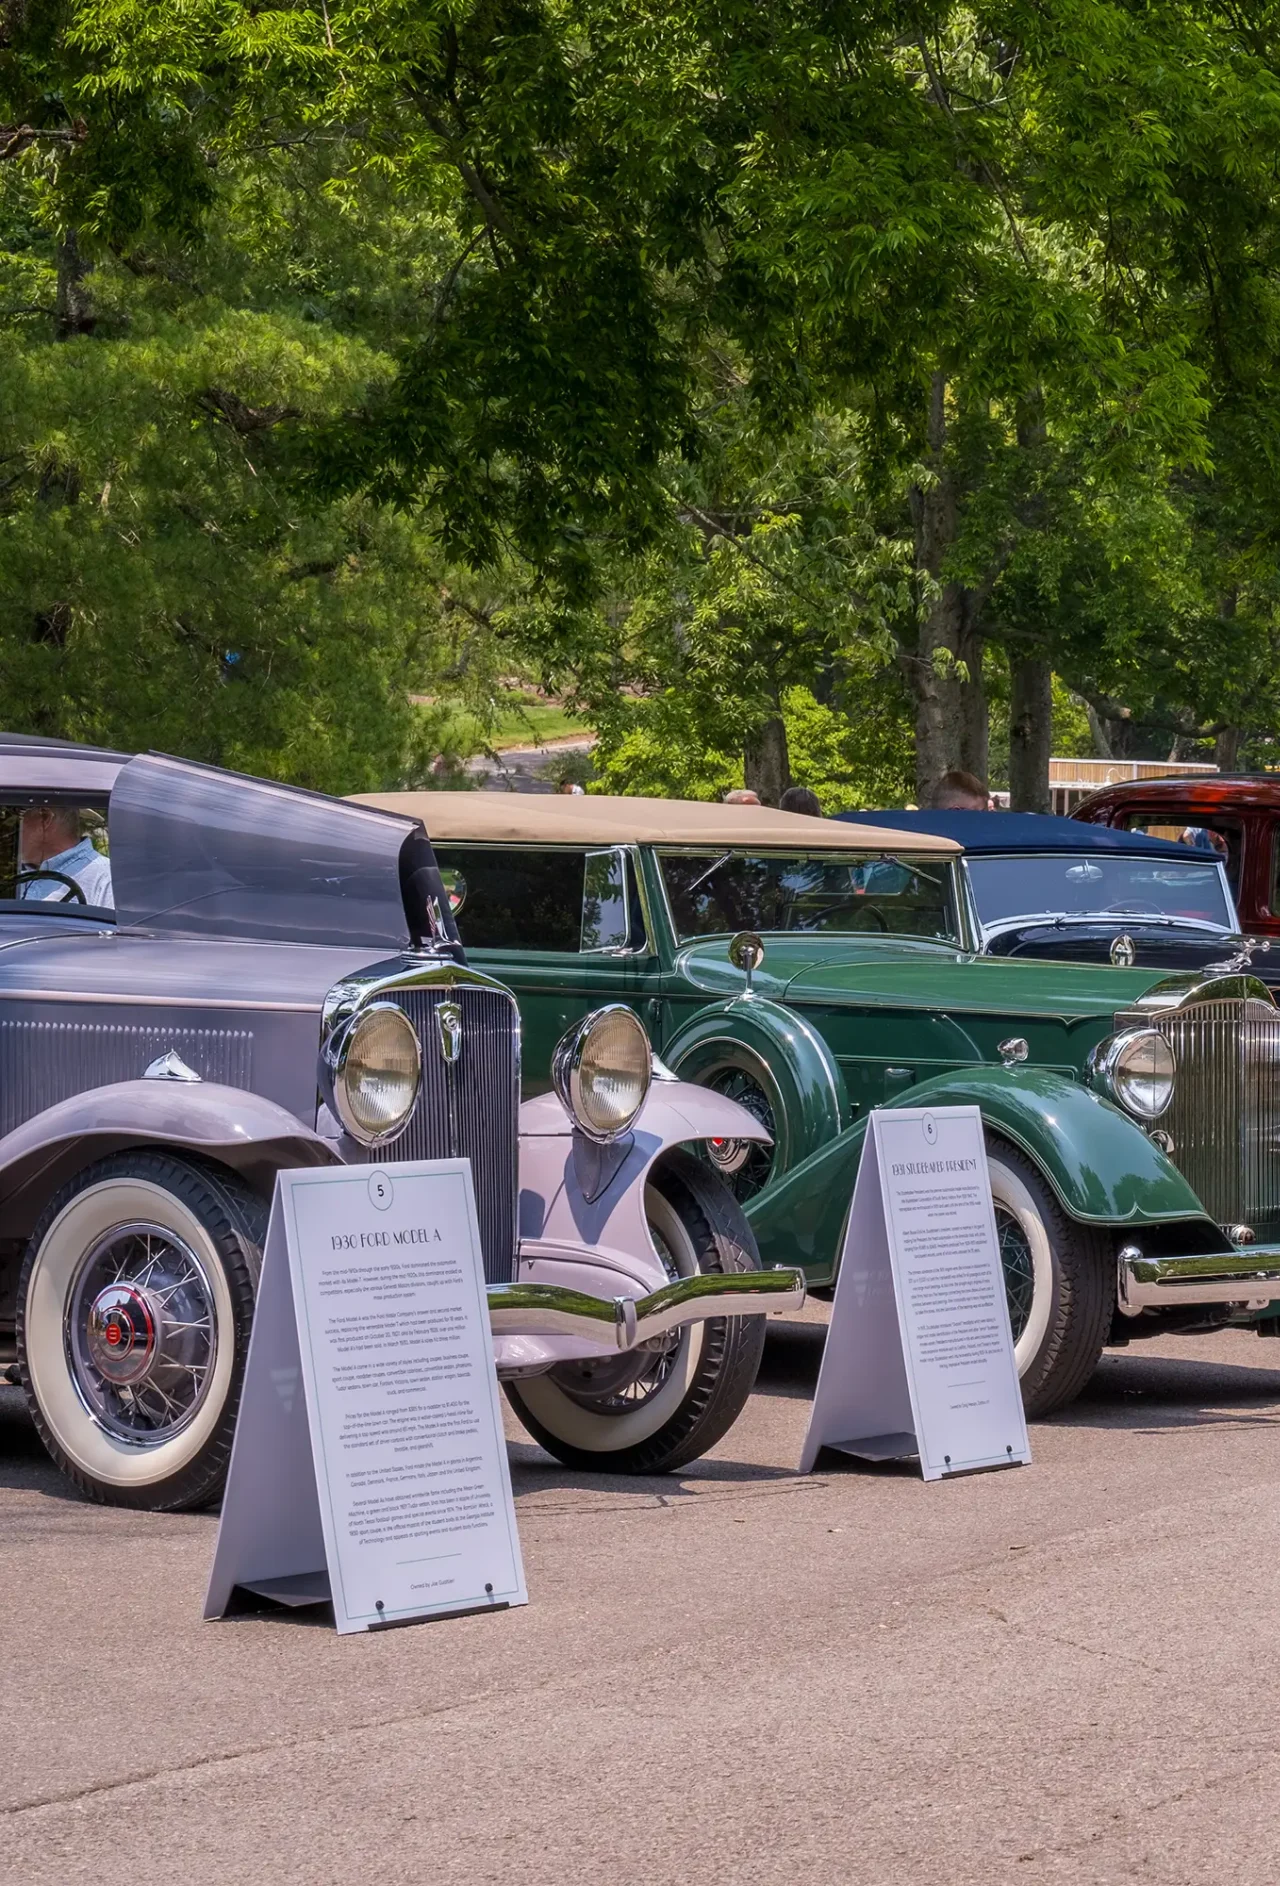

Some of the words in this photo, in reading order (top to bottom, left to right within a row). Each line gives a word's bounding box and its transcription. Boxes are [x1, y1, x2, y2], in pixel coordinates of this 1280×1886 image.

[928, 1124, 933, 1134] 6
[377, 1184, 384, 1197] 5
[331, 1234, 357, 1250] 1930
[360, 1231, 390, 1248] FORD
[393, 1228, 430, 1244] MODEL
[434, 1228, 442, 1241] A
